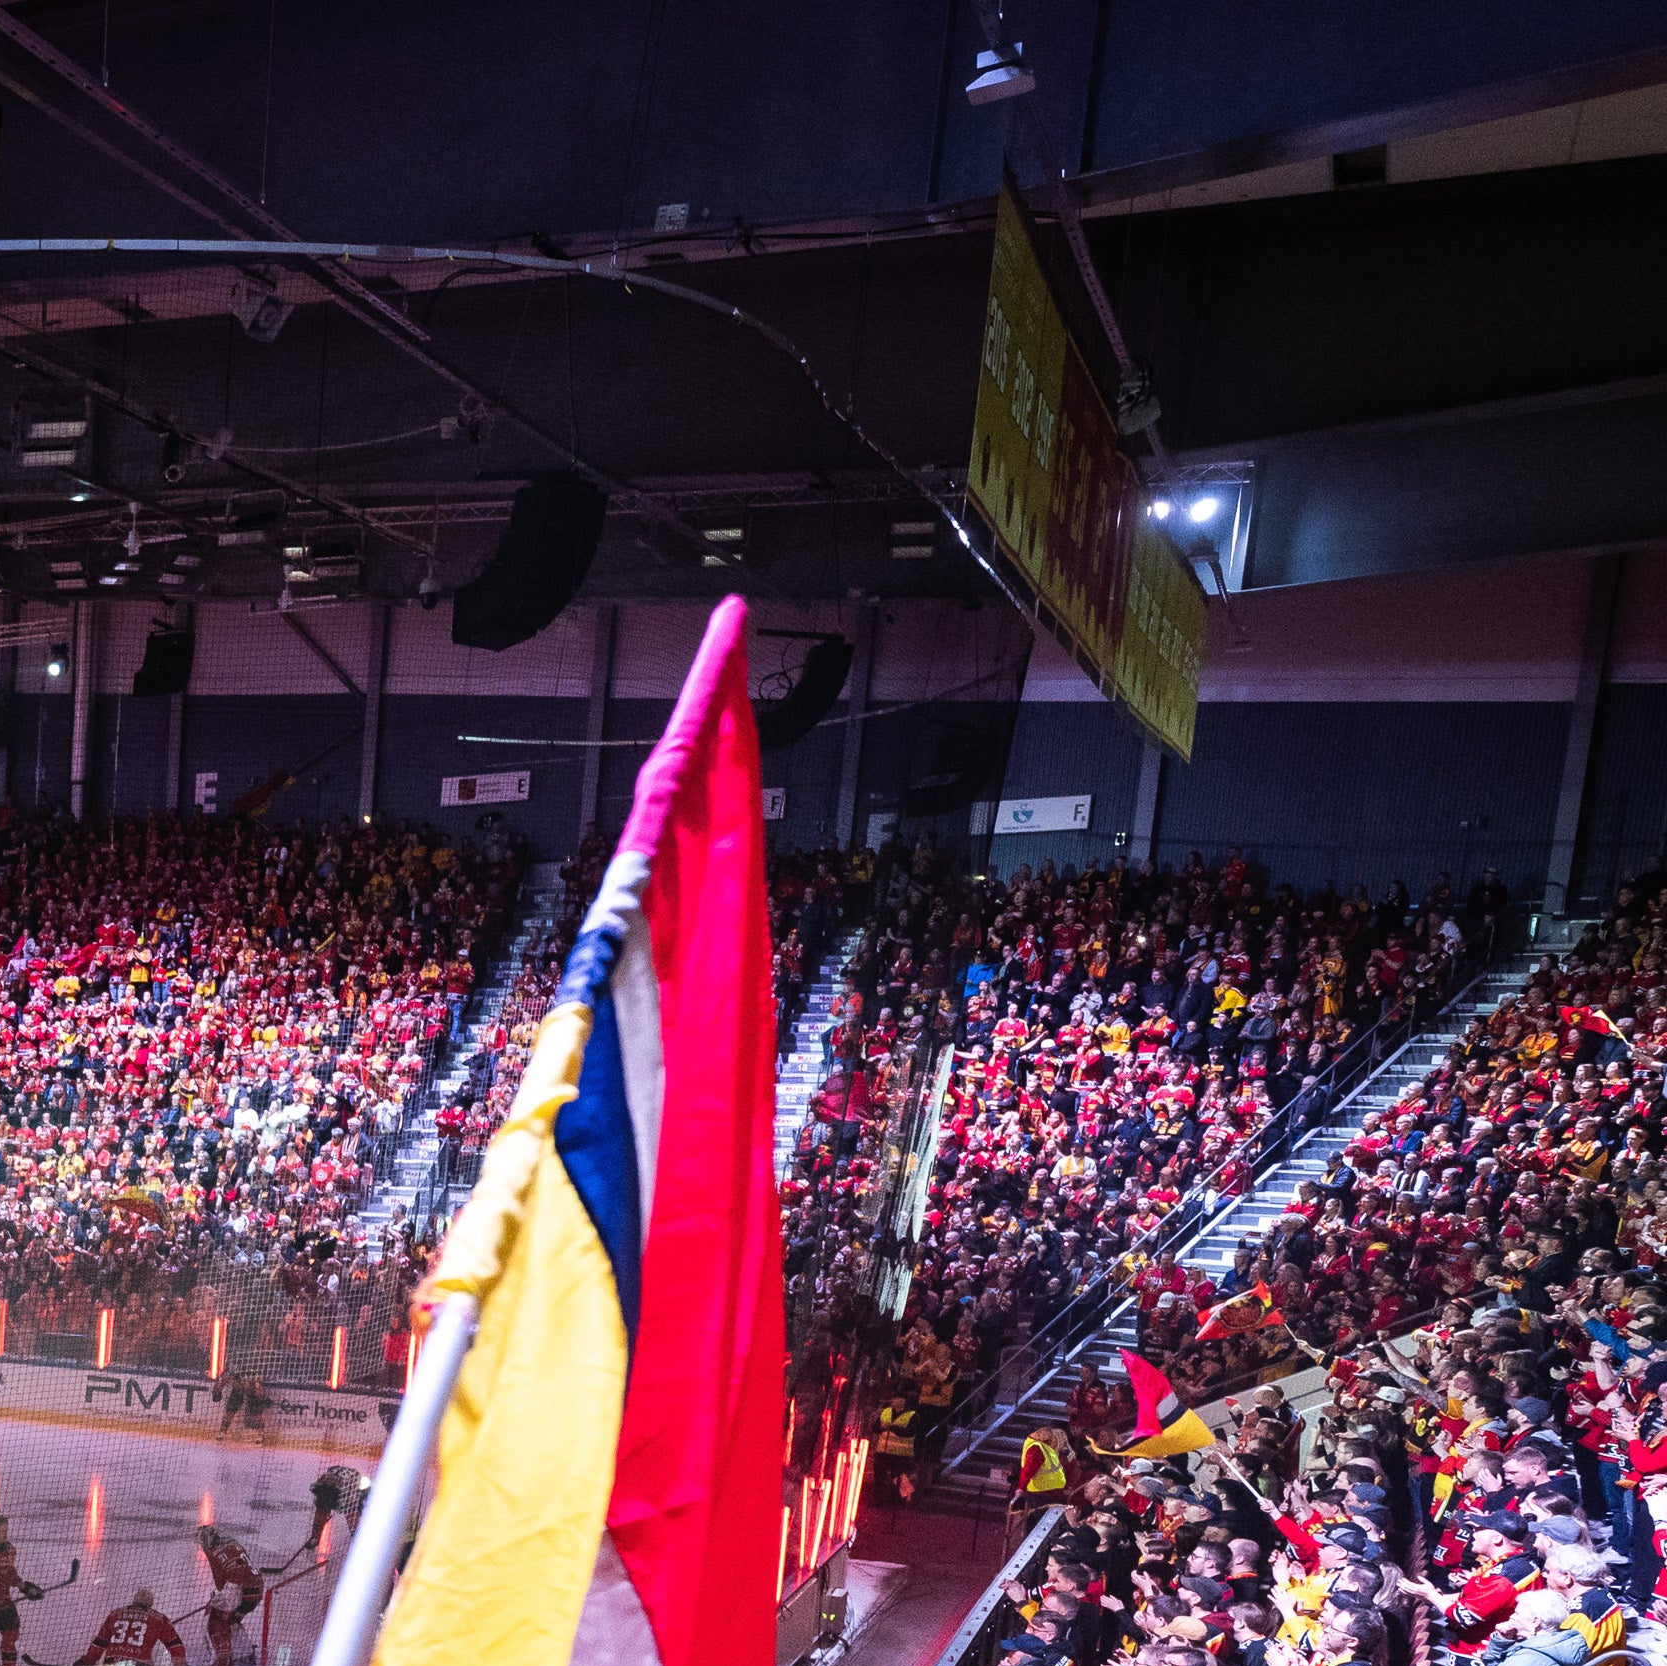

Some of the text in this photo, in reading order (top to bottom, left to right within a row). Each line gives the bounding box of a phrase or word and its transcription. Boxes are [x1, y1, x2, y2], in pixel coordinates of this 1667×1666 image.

[194, 772, 218, 813] E
[85, 1375, 210, 1413] PMT
[314, 1400, 368, 1423] home
[110, 1620, 148, 1647] 33
